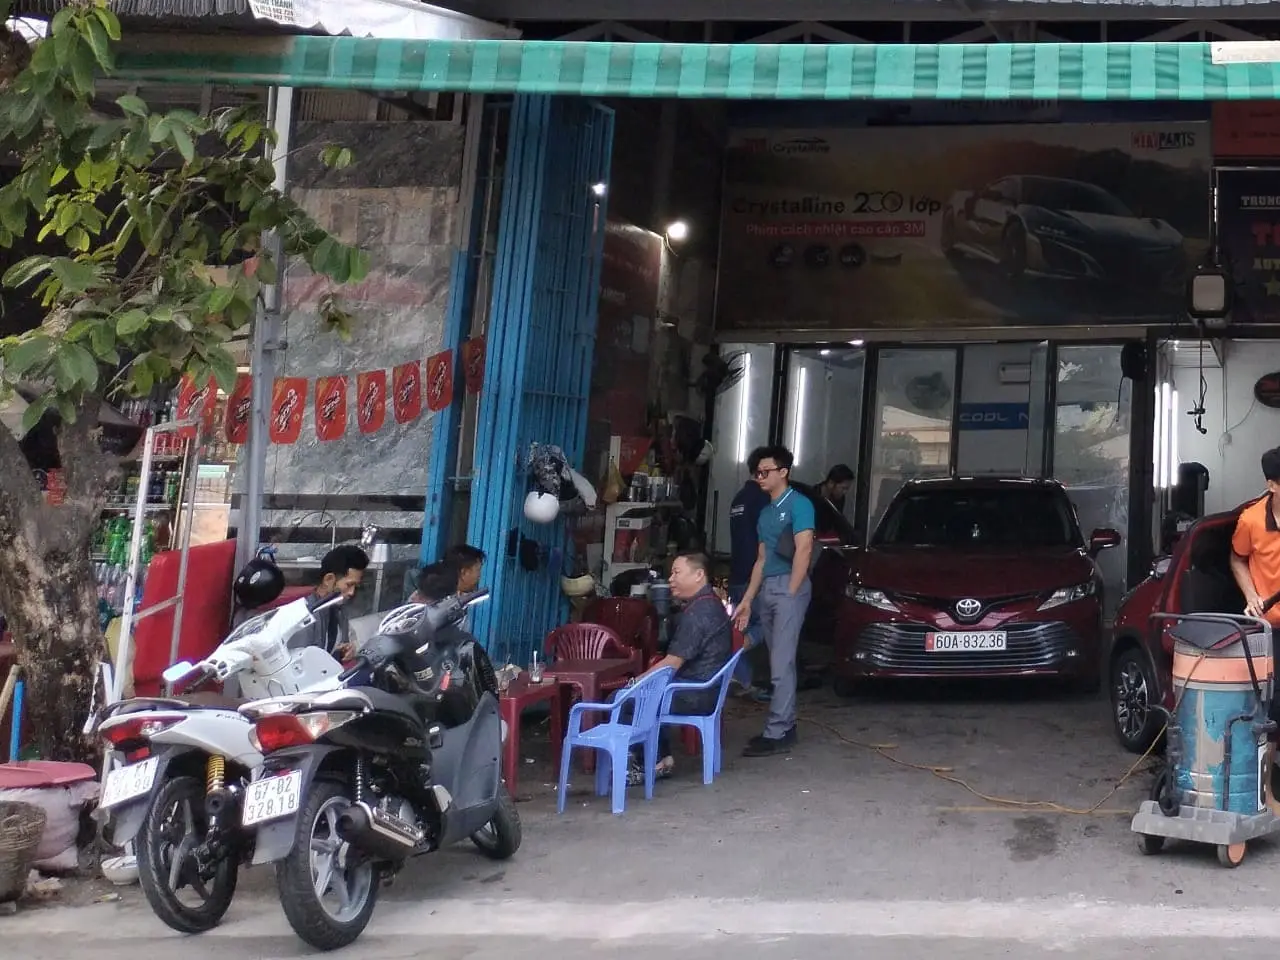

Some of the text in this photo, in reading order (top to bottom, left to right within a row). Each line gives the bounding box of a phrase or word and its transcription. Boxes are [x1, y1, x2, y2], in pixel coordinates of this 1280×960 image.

[731, 196, 846, 216] Crystalline
[908, 194, 942, 216] lớp
[746, 223, 926, 238] Phim cách nhiệt cao cấp 3M
[959, 412, 1009, 422] COOL
[935, 634, 1004, 649] 60A-832.36
